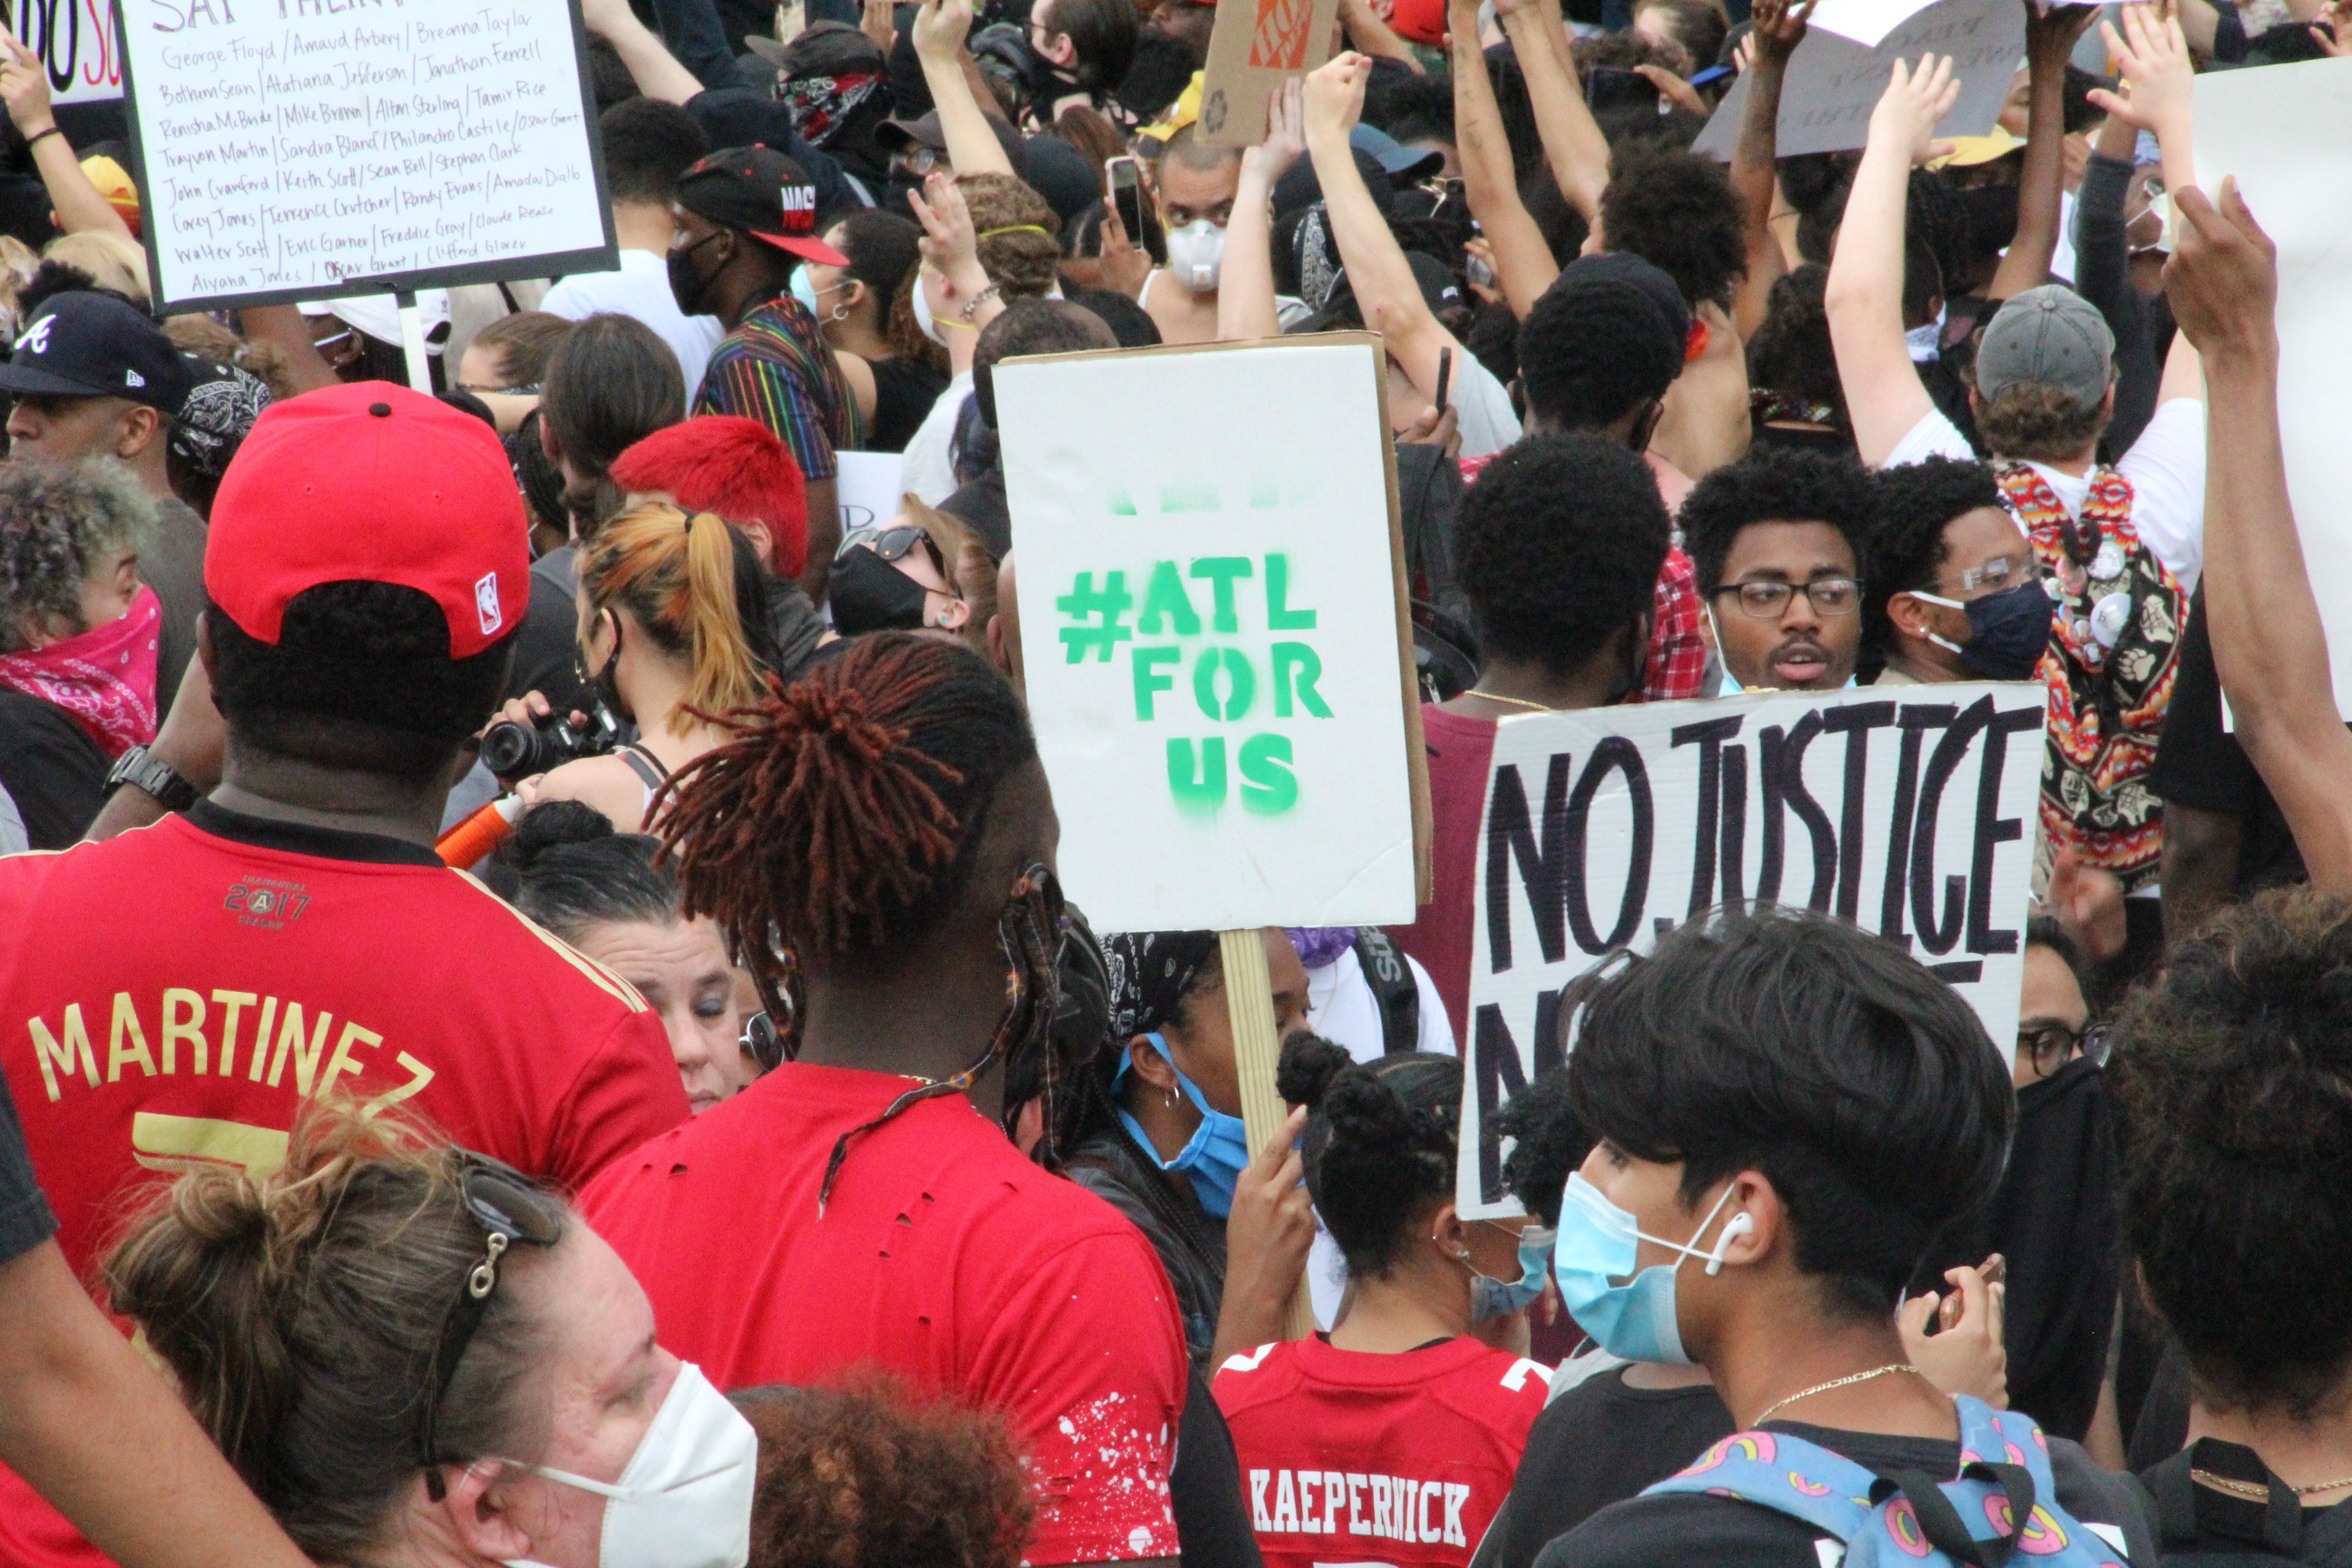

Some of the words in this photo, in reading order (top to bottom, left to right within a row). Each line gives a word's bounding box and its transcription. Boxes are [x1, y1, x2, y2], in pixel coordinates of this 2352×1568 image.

[162, 46, 227, 72] George
[227, 36, 276, 71] Floyd
[355, 26, 400, 51] Arbery
[332, 62, 407, 90] Jefferson
[492, 39, 542, 65] Ferrell
[160, 117, 216, 140] Renisha
[284, 103, 318, 129] Mike
[318, 102, 362, 124] Brown
[471, 87, 513, 110] Tamir
[515, 80, 546, 99] Rice
[157, 146, 217, 172] Trayvon
[219, 141, 269, 164] Martin
[279, 137, 334, 162] Sandra
[335, 132, 380, 159] Bland
[457, 118, 511, 141] Castile
[162, 177, 202, 209] John
[283, 169, 325, 191] Keith
[328, 166, 358, 189] Scott
[367, 158, 401, 181] Sean
[403, 155, 427, 175] Bell
[488, 142, 524, 162] Clark
[174, 244, 232, 264] Walter
[236, 239, 270, 259] Scott
[285, 237, 318, 257] Eric
[320, 232, 369, 252] Garner
[380, 227, 430, 248] Freddie
[435, 218, 466, 239] Gray
[475, 210, 514, 228] Claude
[211, 208, 256, 234] Jones
[334, 194, 392, 218] Crutcher
[402, 188, 443, 211] Randy
[445, 181, 483, 201] Evans
[191, 273, 250, 294] Aiyana
[250, 267, 302, 289] Jones
[369, 254, 407, 274] Grant
[426, 240, 478, 265] Clifford
[485, 239, 526, 254] Glover
[1056, 554, 1318, 665] #ATL
[1132, 642, 1335, 722] FOR
[1166, 732, 1299, 818] US
[1485, 736, 1655, 975] NO
[1653, 694, 2044, 956] JUSTICE
[27, 987, 436, 1123] MARTINEZ
[1249, 1468, 1470, 1548] KAEPERNICK
